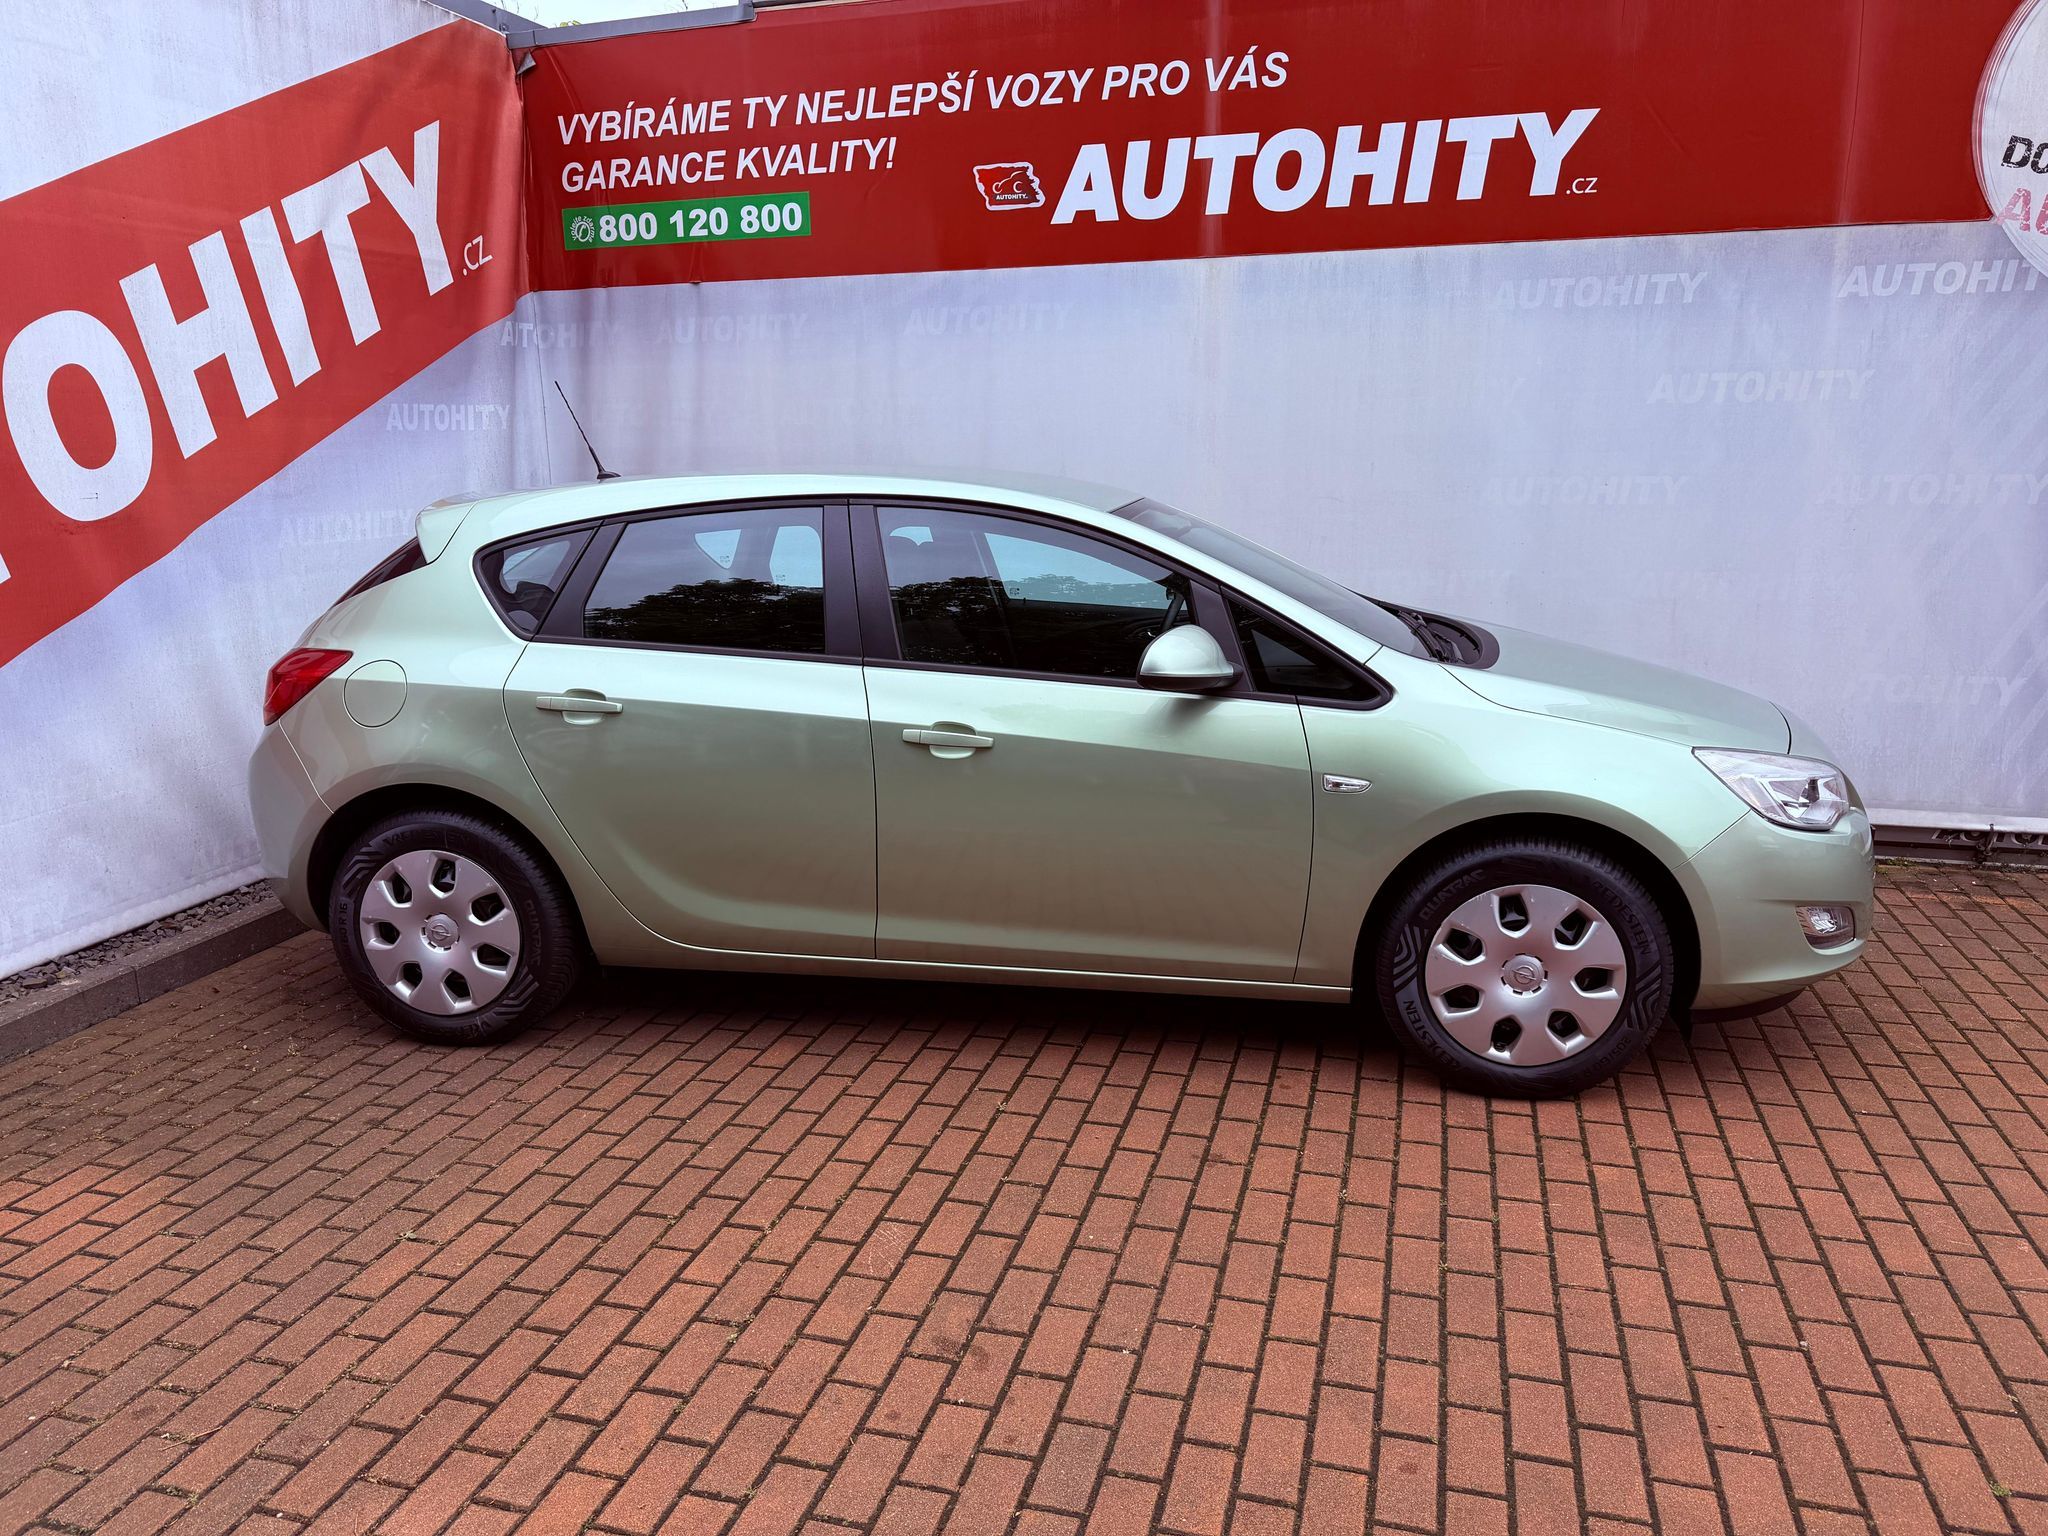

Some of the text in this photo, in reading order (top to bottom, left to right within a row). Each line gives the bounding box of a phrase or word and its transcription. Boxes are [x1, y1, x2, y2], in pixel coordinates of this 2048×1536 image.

[558, 46, 1290, 145] VYBÍRÁME TY NEJLEPŠÍ VOZY PRO VÁS
[562, 136, 897, 193] GARANCE KVALITY!
[599, 202, 803, 243] 800 120 800
[1492, 272, 1708, 311] AUTOHITY
[1646, 368, 1876, 404] AUTOHITY
[386, 403, 511, 431] AUTOHITY
